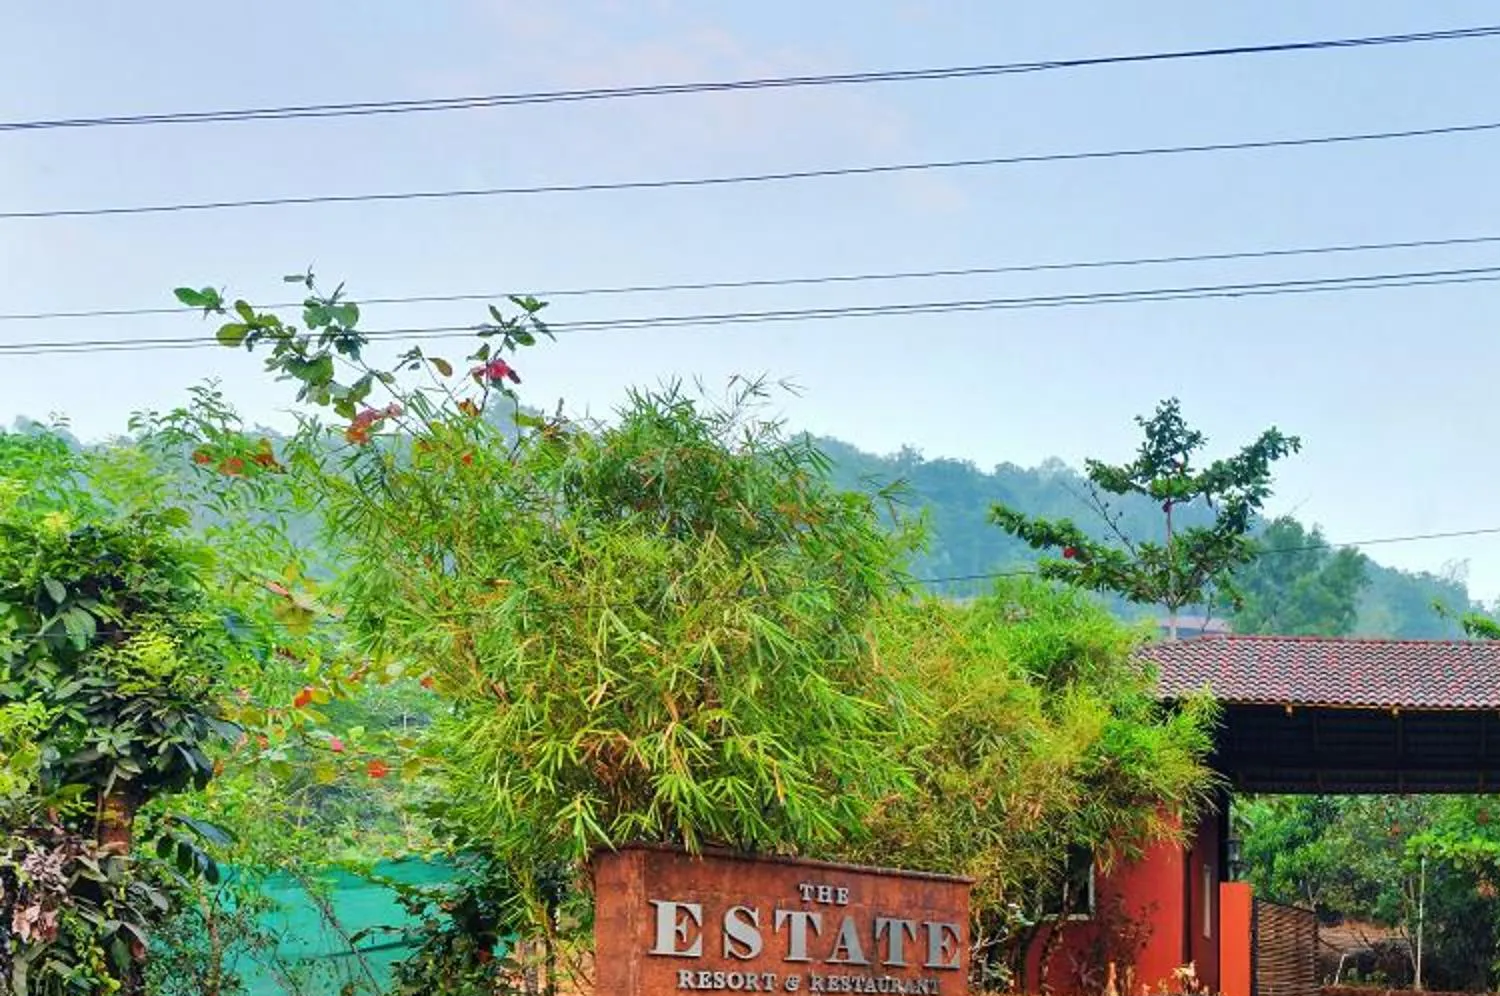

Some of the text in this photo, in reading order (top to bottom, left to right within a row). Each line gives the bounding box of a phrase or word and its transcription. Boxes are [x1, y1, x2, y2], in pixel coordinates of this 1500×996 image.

[799, 883, 849, 905] THE
[648, 899, 962, 969] ESTATE
[678, 969, 942, 996] RESORT & RESTAURANT
